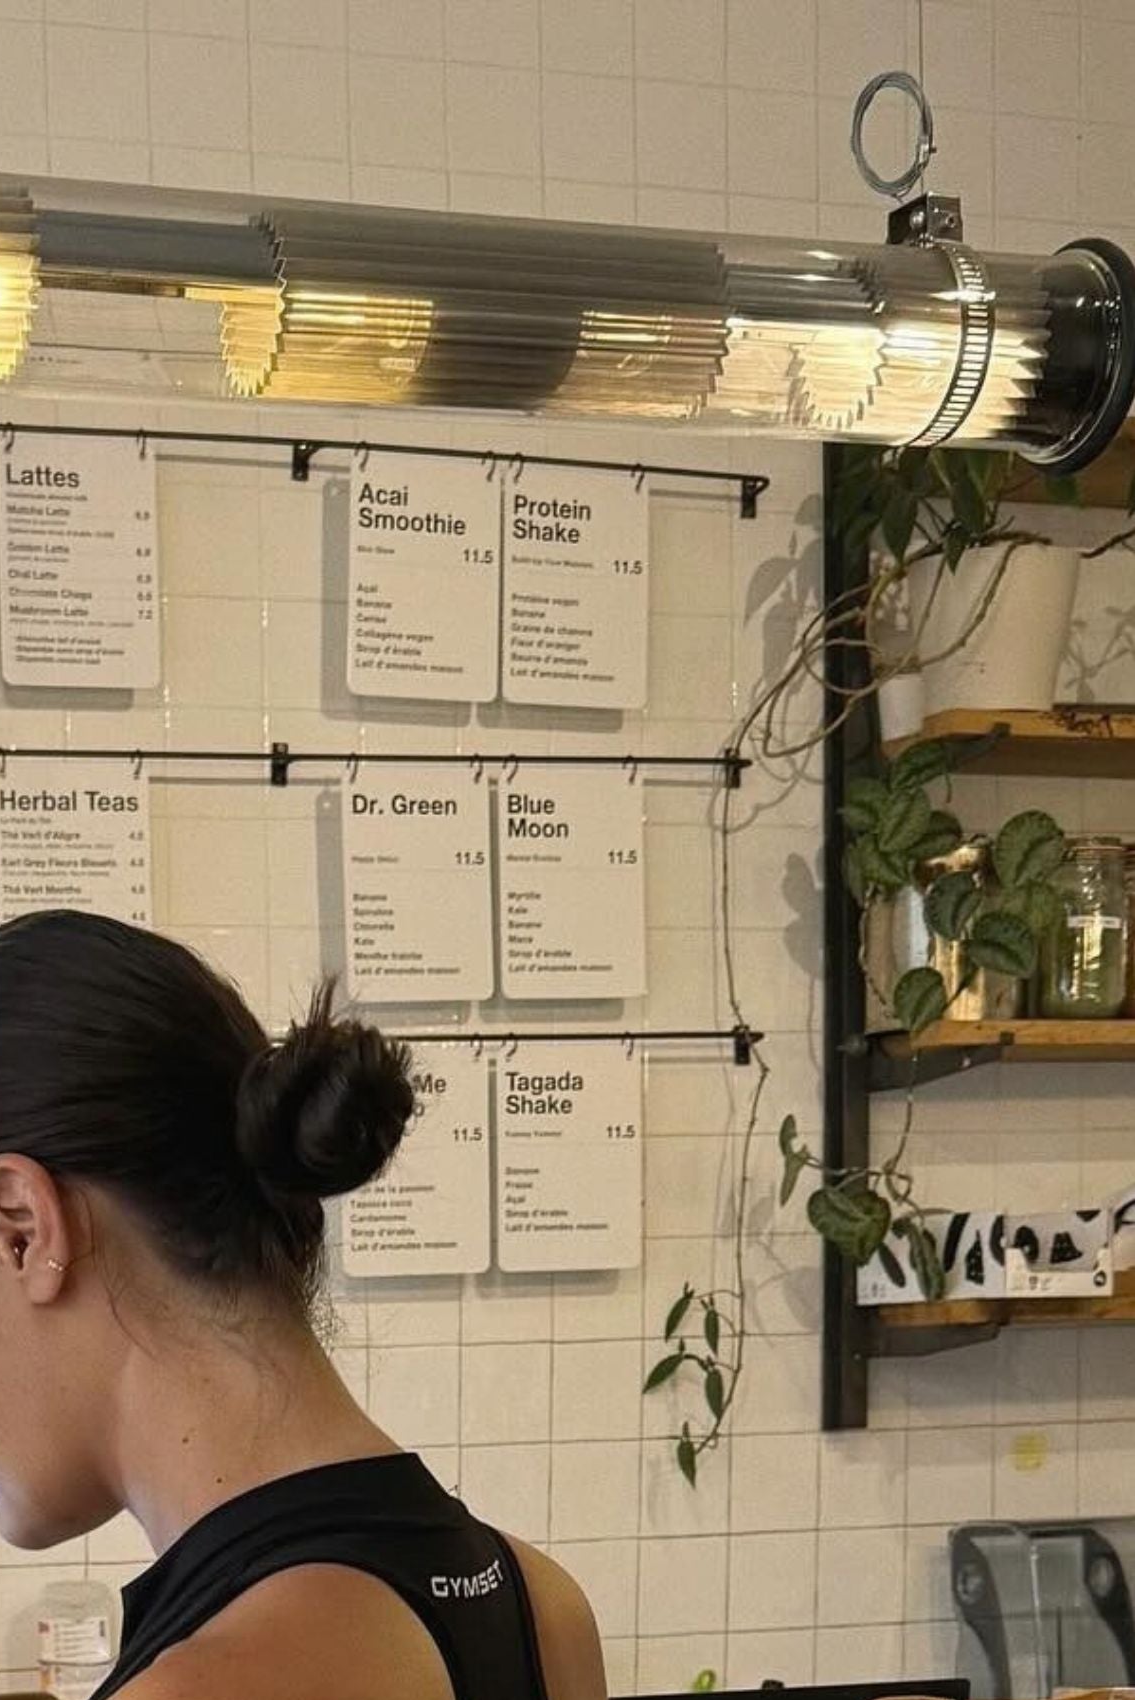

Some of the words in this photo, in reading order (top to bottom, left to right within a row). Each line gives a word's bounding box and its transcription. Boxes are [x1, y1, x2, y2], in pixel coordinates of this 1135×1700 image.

[7, 463, 79, 488] Lattes
[359, 483, 408, 506] Acai
[514, 495, 591, 520] Protein
[359, 508, 465, 535] Smoothie
[513, 519, 579, 543] Shake
[464, 550, 493, 563] 11.5
[614, 561, 642, 575] 11.5
[0, 790, 77, 811] Herbal
[84, 792, 138, 811] Teas
[353, 794, 384, 815] Dr.
[392, 795, 457, 815] Green
[508, 795, 555, 815] Blue
[508, 818, 569, 838] Moon
[456, 853, 484, 865] 11.5
[608, 851, 637, 864] 11.5
[506, 1072, 583, 1095] Tagada
[506, 1095, 572, 1115] Shake
[454, 1129, 482, 1142] 11.5
[607, 1125, 635, 1138] 11.5
